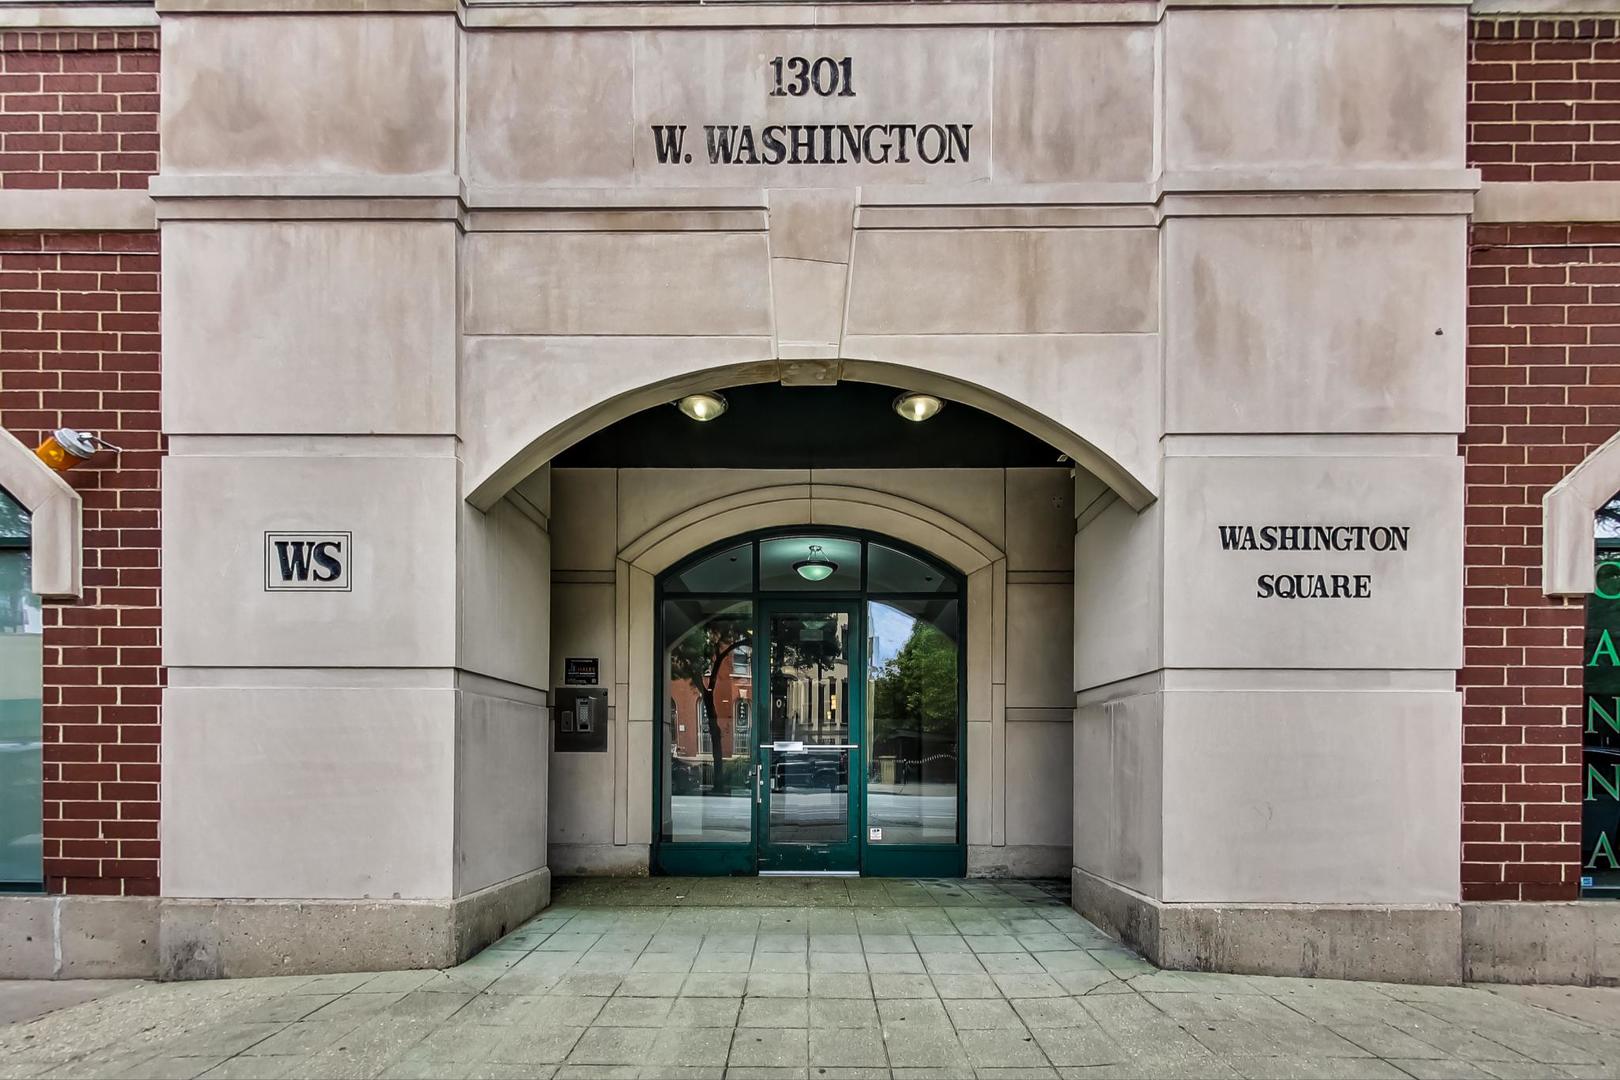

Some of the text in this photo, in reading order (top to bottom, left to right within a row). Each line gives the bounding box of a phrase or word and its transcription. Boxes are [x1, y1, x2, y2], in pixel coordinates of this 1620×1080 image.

[769, 56, 857, 97] 1301
[651, 124, 974, 165] W. WASHINGTON
[1218, 525, 1410, 551] WASHINGTON
[274, 541, 342, 581] WS
[1257, 574, 1371, 599] SQUARE
